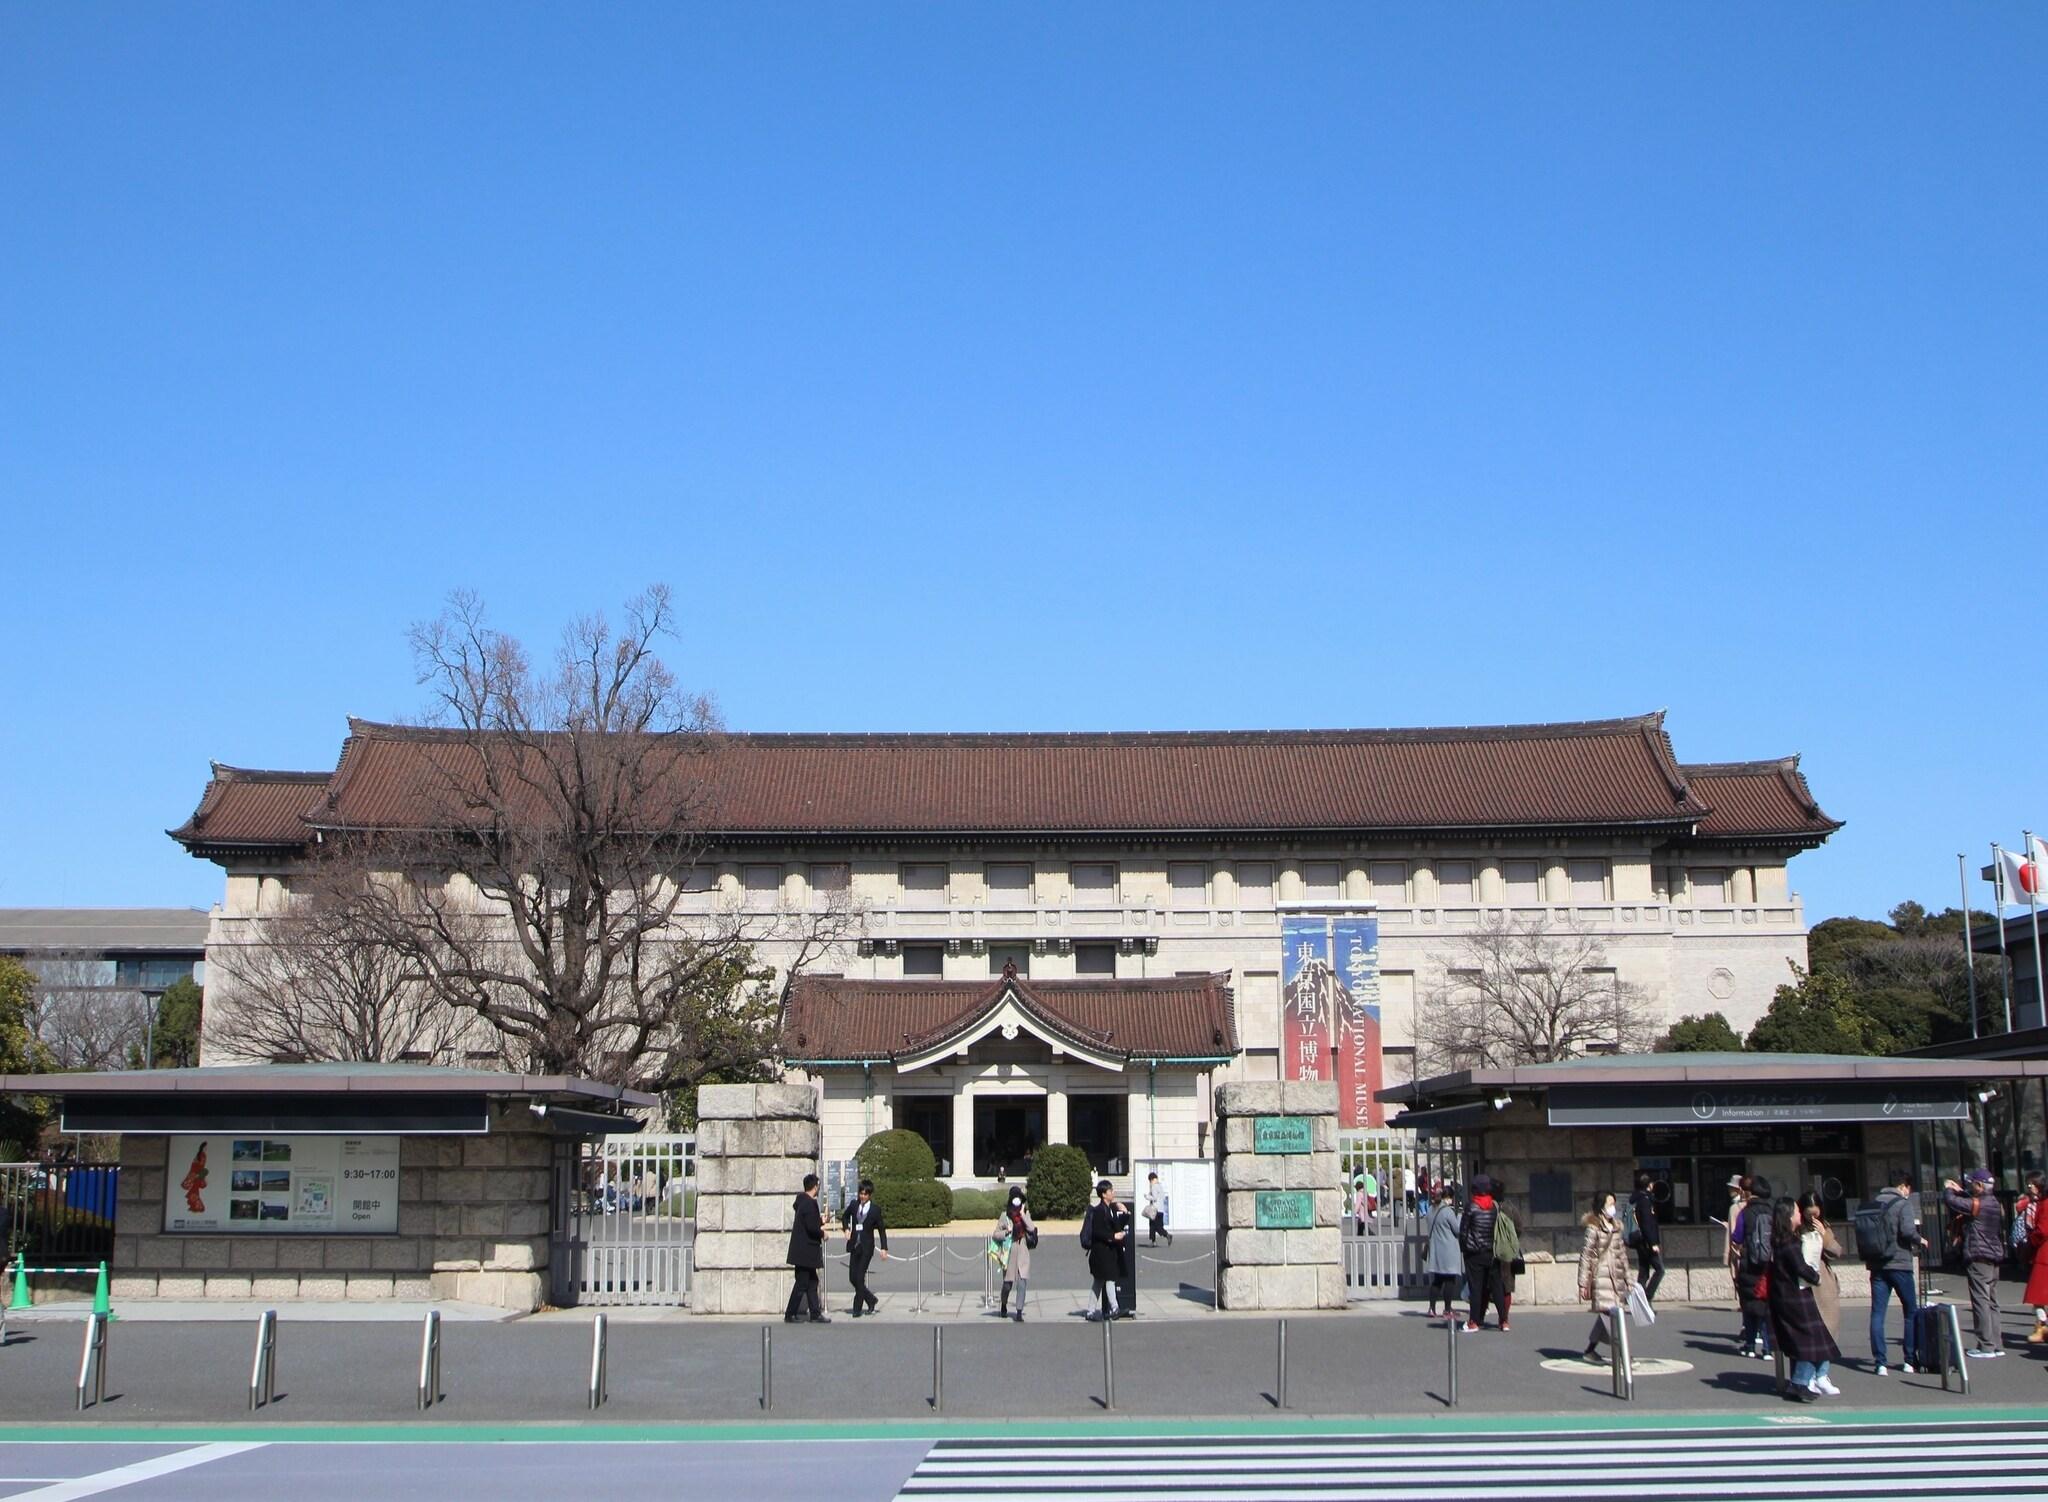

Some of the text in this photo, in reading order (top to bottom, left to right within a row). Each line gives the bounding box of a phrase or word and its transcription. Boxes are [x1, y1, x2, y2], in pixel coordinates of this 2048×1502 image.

[1350, 935, 1363, 988] TOKYO
[1351, 995, 1366, 1077] NATIONAL
[1722, 1109, 1764, 1117] Information
[353, 1199, 381, 1211] 開館中
[352, 1213, 371, 1222] Open
